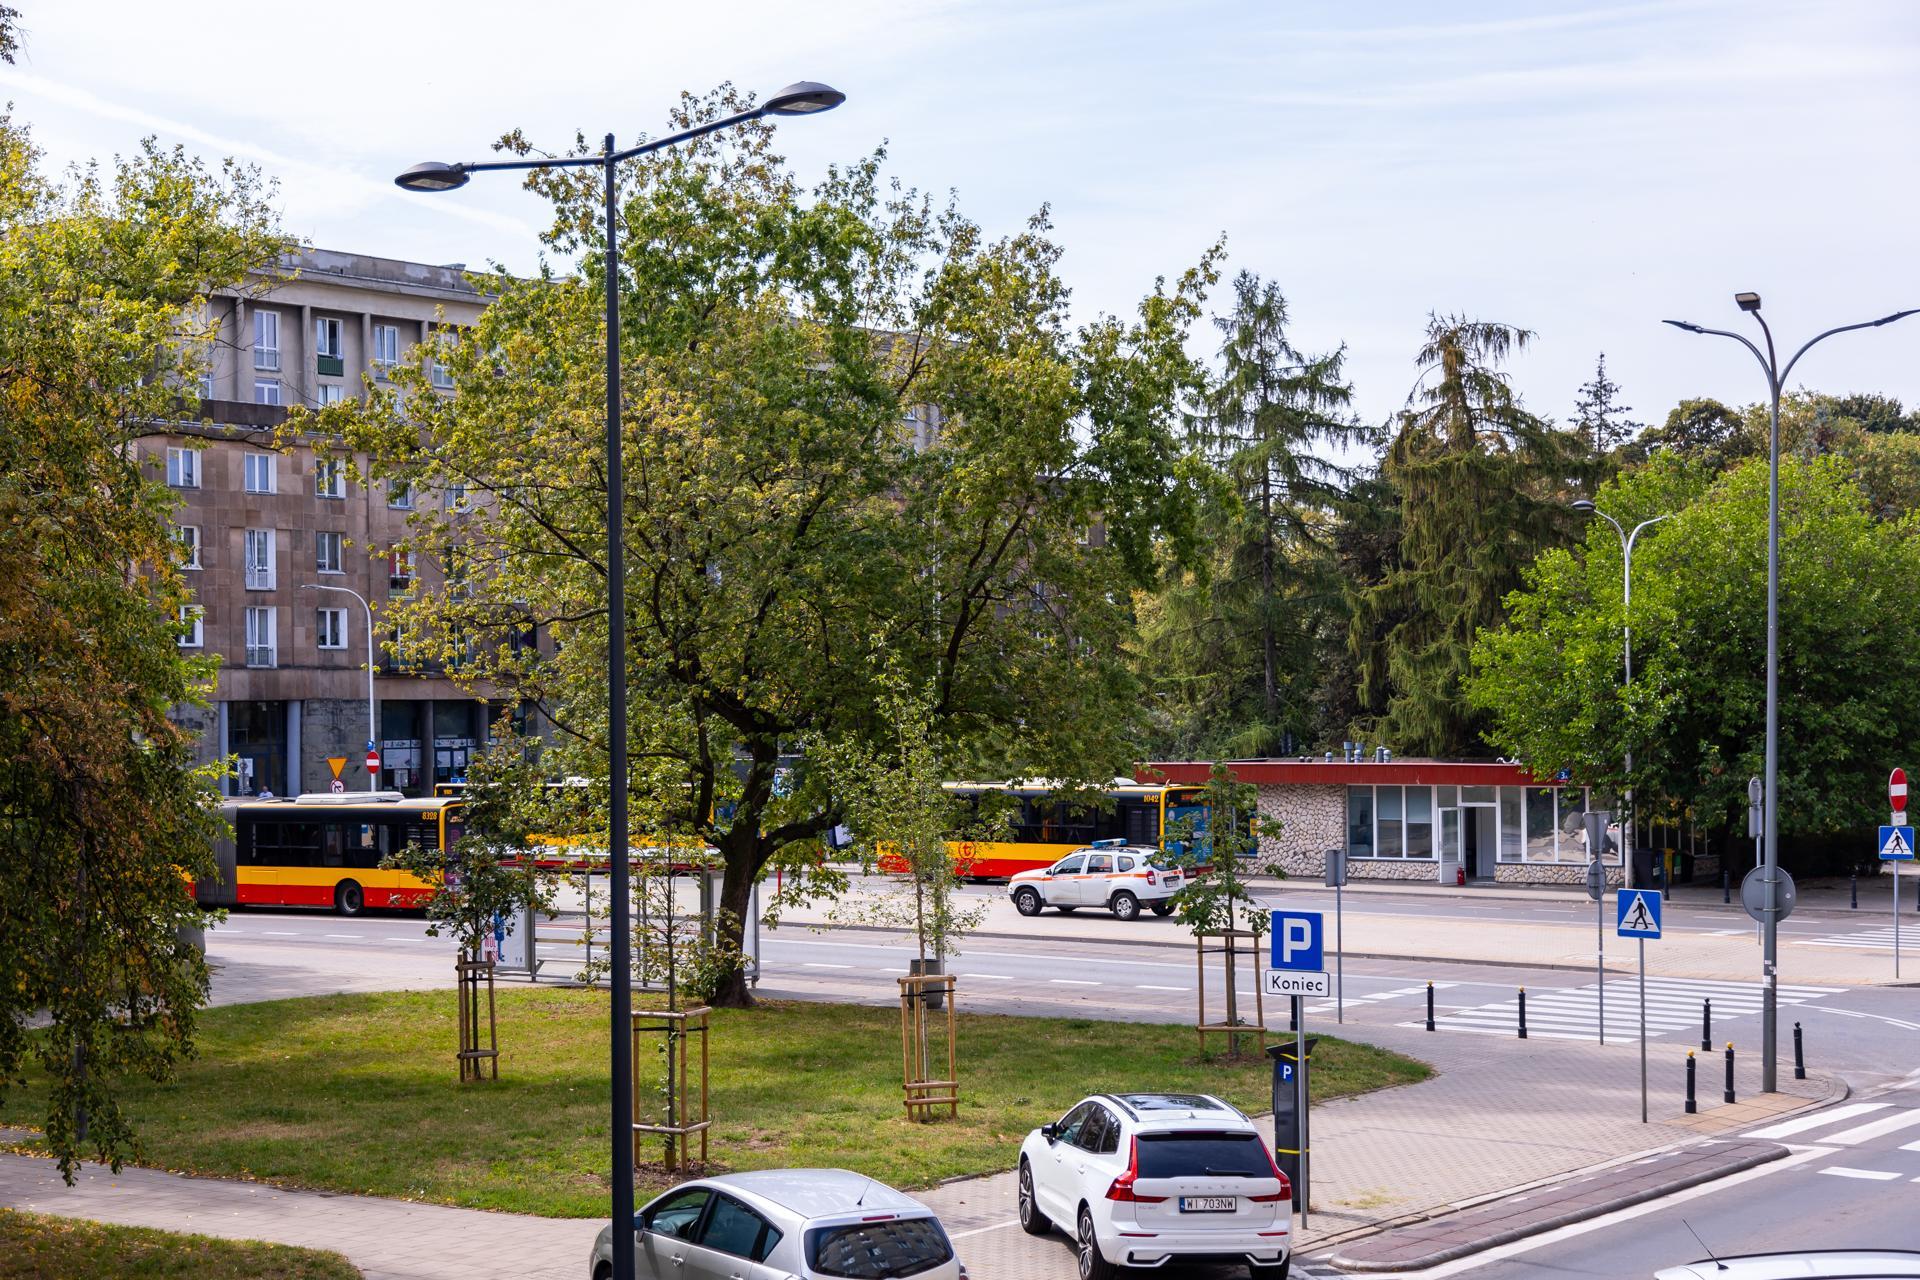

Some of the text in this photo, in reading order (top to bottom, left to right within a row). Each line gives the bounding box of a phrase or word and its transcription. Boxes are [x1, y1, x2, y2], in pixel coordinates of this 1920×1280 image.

[1143, 794, 1159, 803] 1042
[1283, 917, 1312, 963] P
[1271, 975, 1323, 992] Koniec
[1283, 1065, 1292, 1080] P
[1186, 1198, 1234, 1209] WI 703NW
